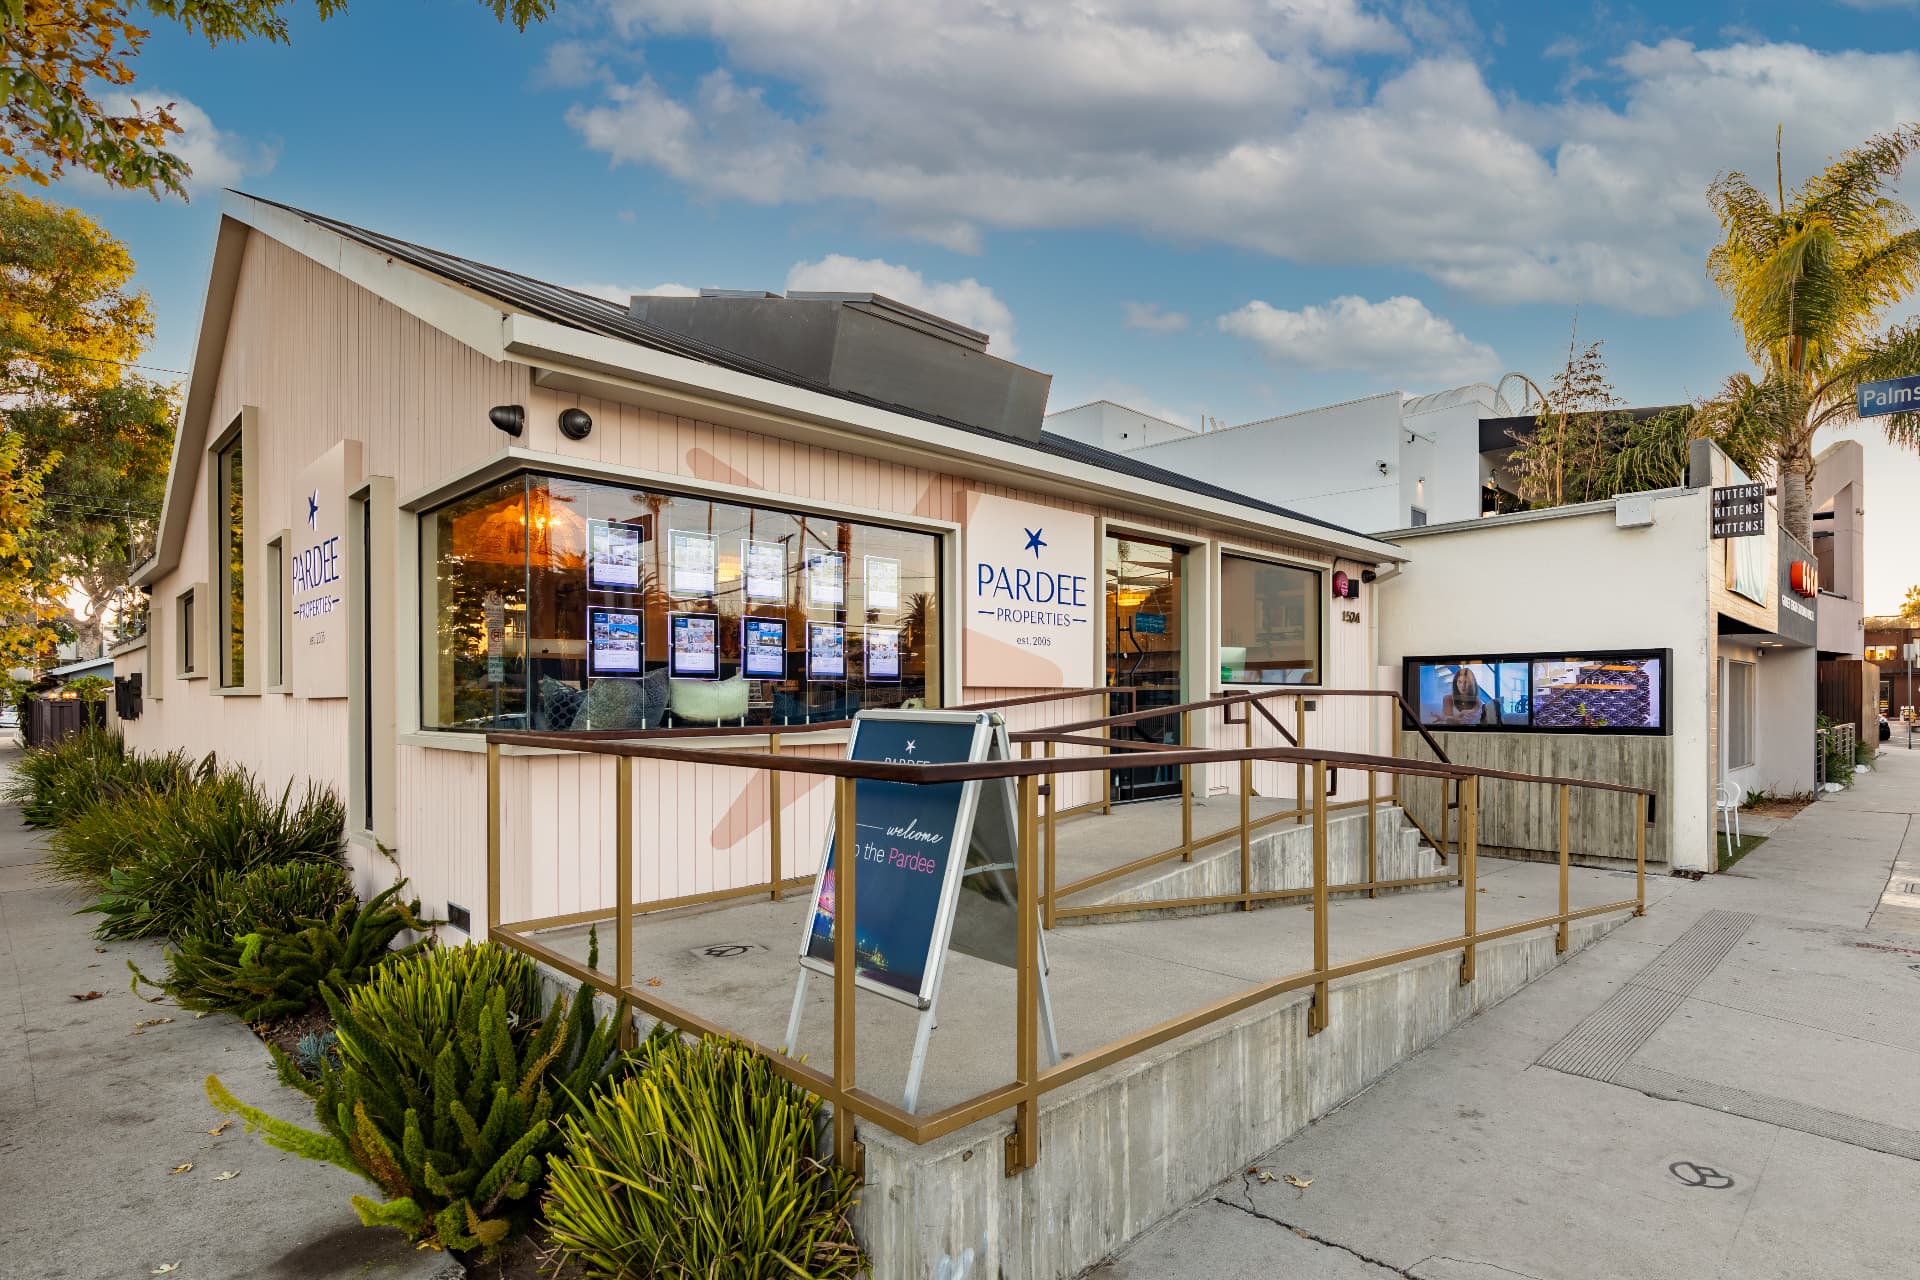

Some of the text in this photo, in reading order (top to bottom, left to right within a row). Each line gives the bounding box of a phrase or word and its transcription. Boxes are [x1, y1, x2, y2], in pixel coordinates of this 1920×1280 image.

[1863, 386, 1920, 408] Palms
[1714, 486, 1763, 500] KITTENS!
[1714, 503, 1763, 517] KITTENS!
[1714, 520, 1763, 534] KITTENS!
[292, 536, 340, 595] PARDEE
[978, 563, 1087, 607] PARDEE
[299, 595, 332, 620] PROPERTIES
[997, 607, 1071, 627] PROPERTIES
[1033, 636, 1051, 646] 2005
[886, 818, 943, 844] welcome
[863, 841, 885, 863] the
[888, 847, 936, 874] Pardee
